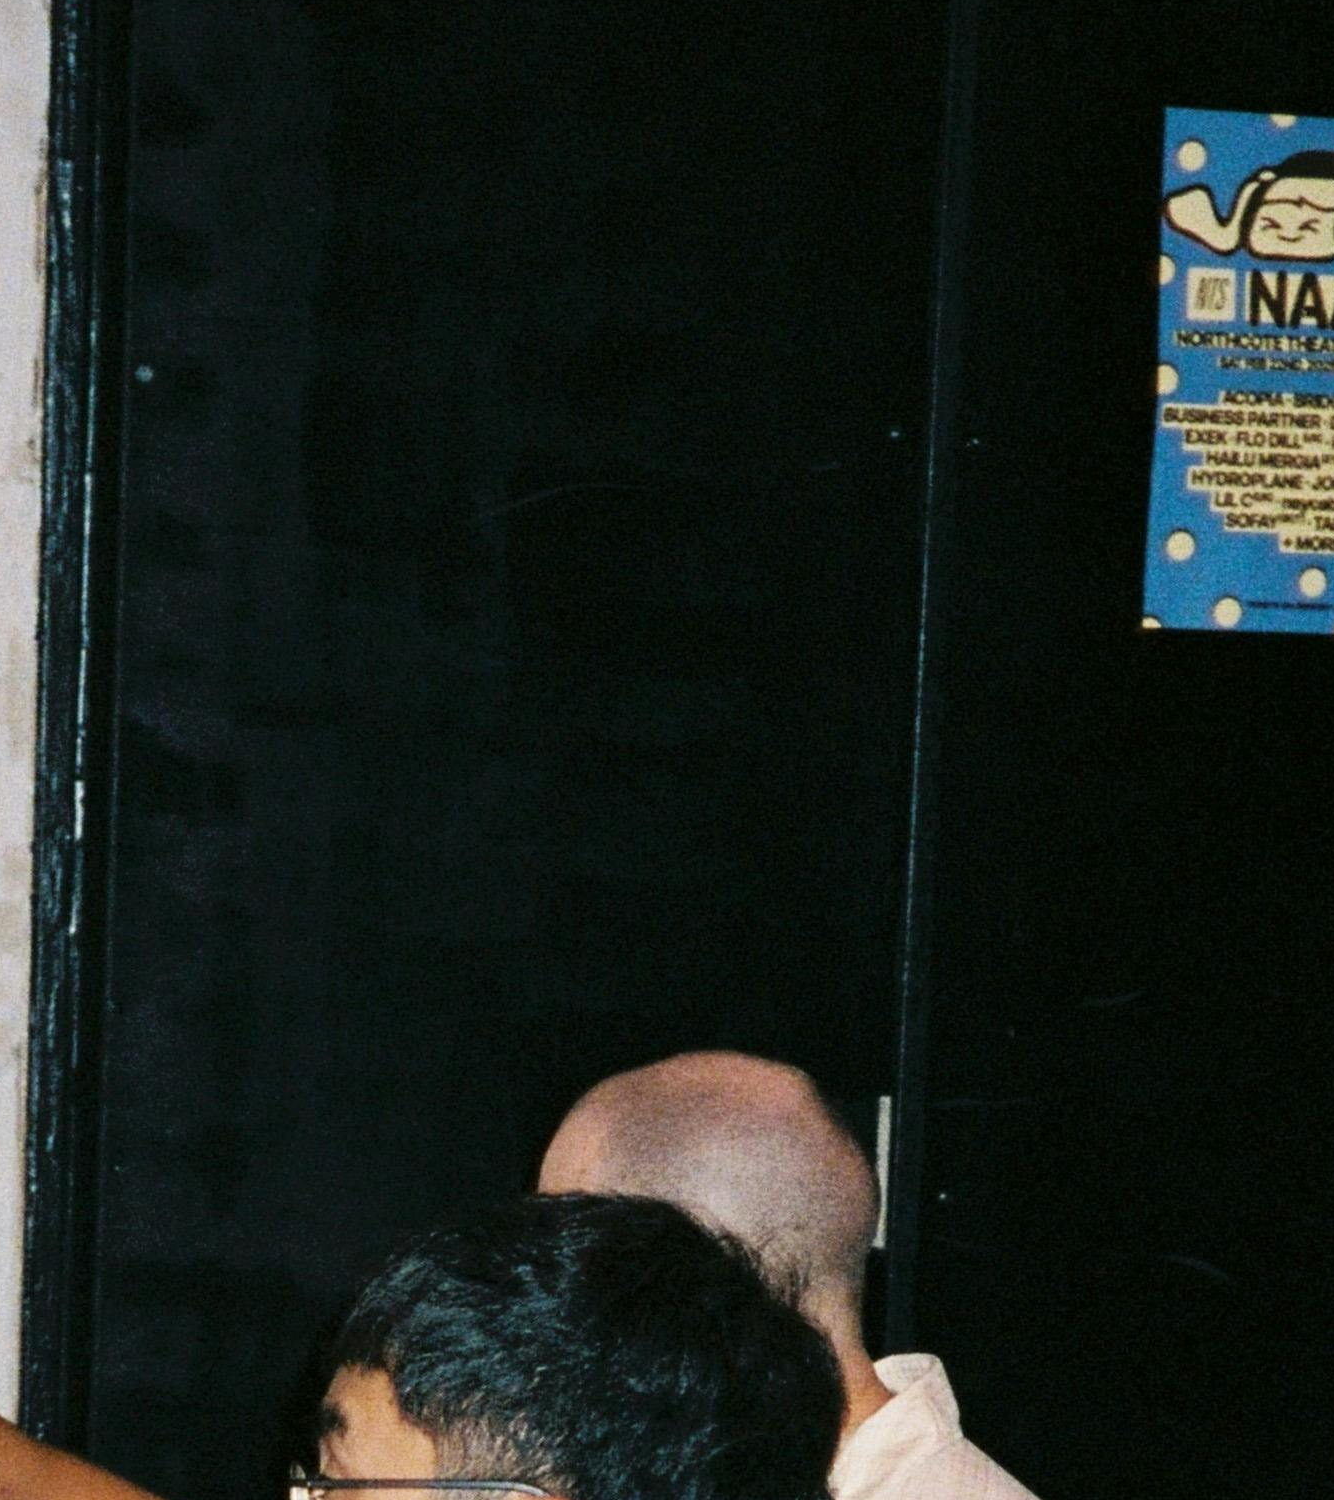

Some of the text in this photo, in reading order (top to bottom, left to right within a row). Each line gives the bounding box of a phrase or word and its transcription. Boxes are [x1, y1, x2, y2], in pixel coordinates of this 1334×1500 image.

[1176, 331, 1283, 350] NORTHCOTE
[1221, 391, 1283, 405] ACOPIA
[1163, 406, 1245, 426] BUSINESS
[1248, 411, 1322, 428] PARTNER
[1185, 429, 1227, 444] EXEK
[1236, 431, 1266, 447] FLO
[1269, 433, 1302, 449] DILL
[1259, 454, 1322, 469] MERGIA
[1191, 469, 1304, 490] HYDROPLANE
[1214, 492, 1239, 507] LIL
[1225, 512, 1277, 528] SOFAY
